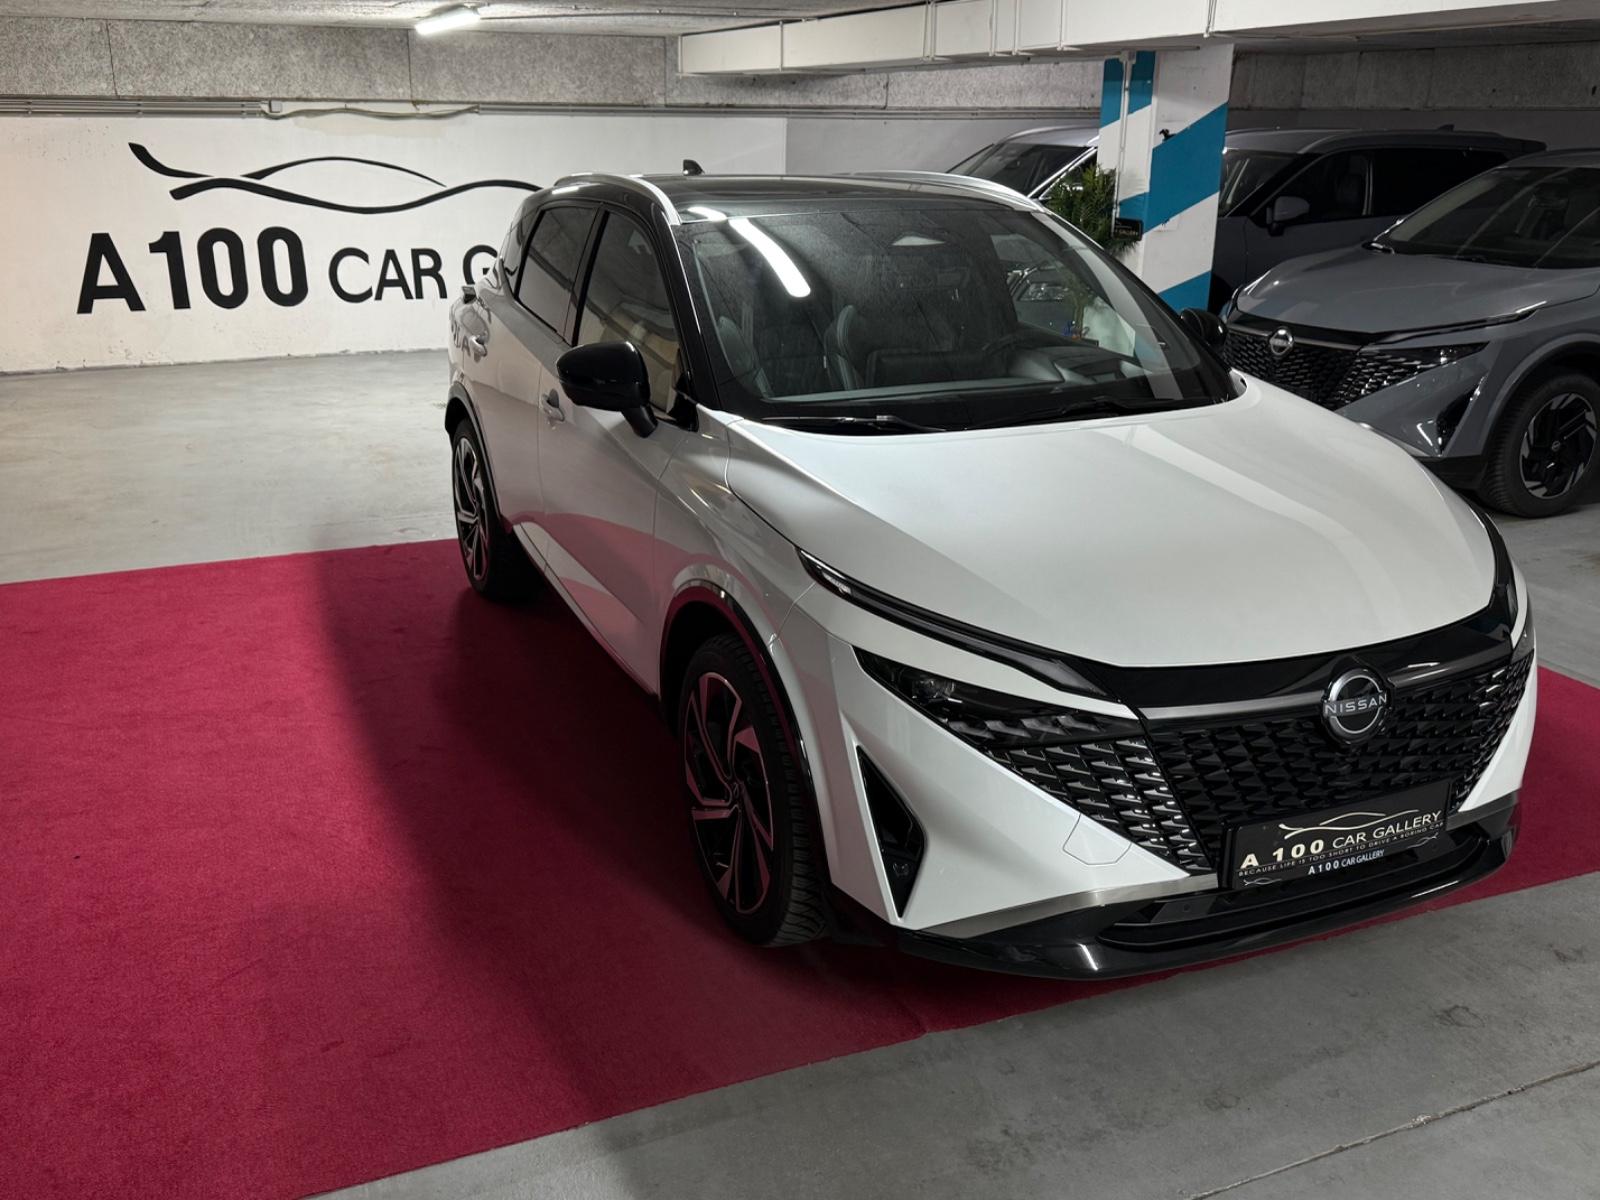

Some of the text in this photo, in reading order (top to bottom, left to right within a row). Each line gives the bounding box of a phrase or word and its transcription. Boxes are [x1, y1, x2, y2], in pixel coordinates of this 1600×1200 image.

[328, 246, 447, 302] CAR
[1324, 693, 1387, 714] NISSAN
[1332, 832, 1367, 849] CAR
[1372, 810, 1442, 839] GALLERY
[1238, 865, 1277, 876] BECAUSE
[1280, 861, 1296, 869] LIFE
[1309, 854, 1326, 862] TOO
[1328, 847, 1353, 857] SHORT
[1341, 856, 1356, 867] CAR
[1356, 849, 1385, 863] GALLERY
